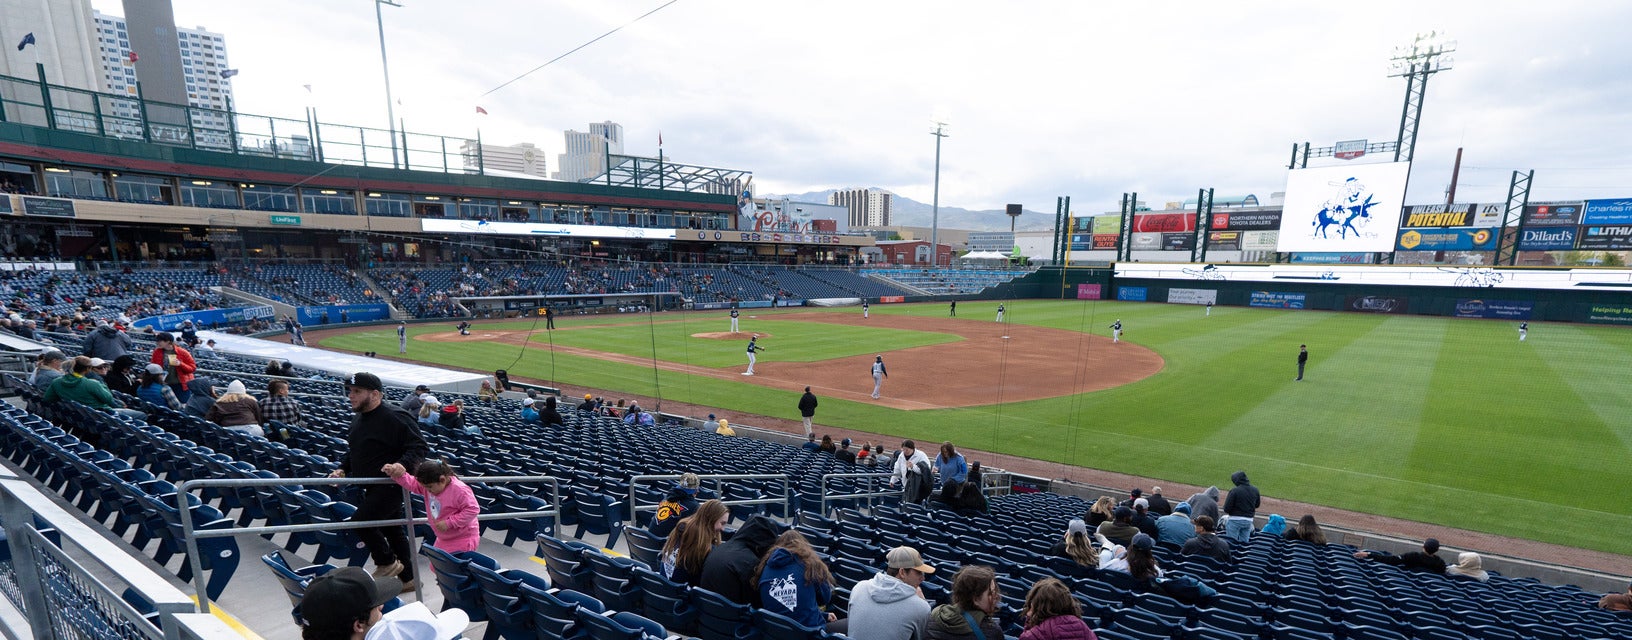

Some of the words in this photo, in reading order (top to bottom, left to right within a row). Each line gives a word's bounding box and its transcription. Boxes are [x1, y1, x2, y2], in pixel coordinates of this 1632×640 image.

[1411, 204, 1448, 214] UNLEASH
[1449, 203, 1470, 213] YOUR
[1406, 212, 1467, 227] POTENTIAL
[1523, 230, 1573, 241] Dillard's
[1339, 254, 1362, 263] Chill
[244, 306, 274, 319] GREATER
[773, 589, 796, 597] NEVADA
